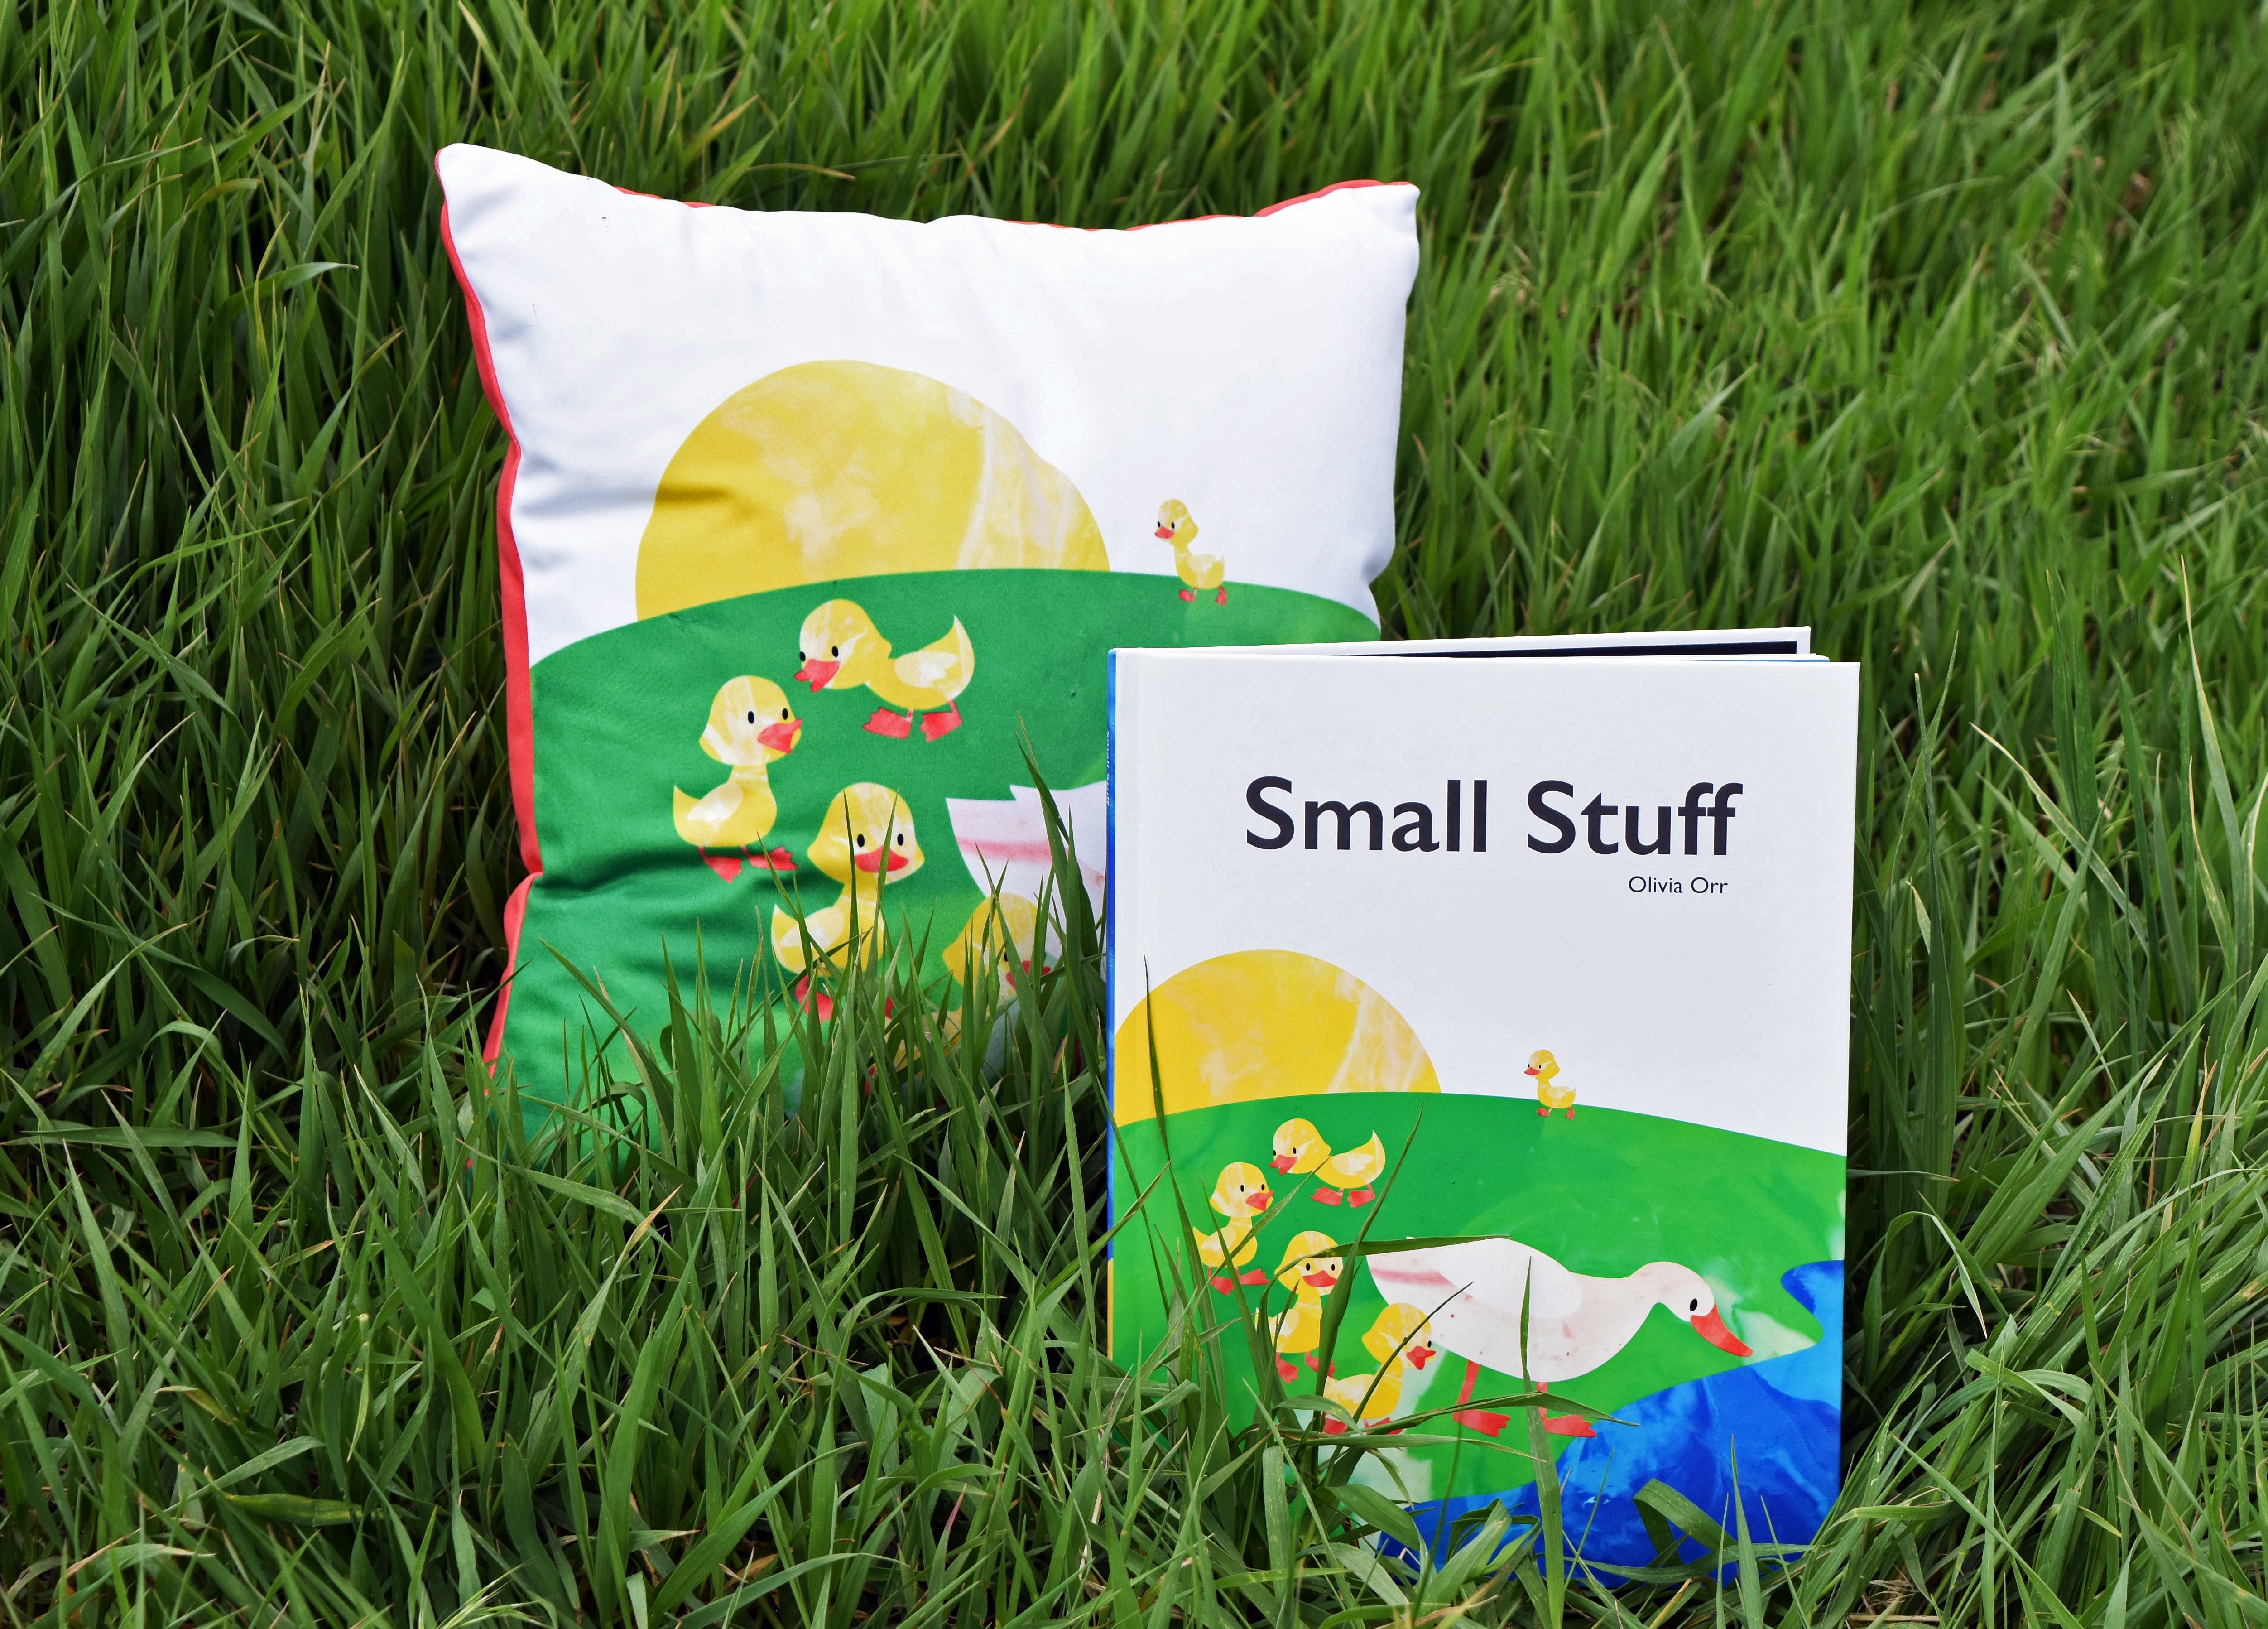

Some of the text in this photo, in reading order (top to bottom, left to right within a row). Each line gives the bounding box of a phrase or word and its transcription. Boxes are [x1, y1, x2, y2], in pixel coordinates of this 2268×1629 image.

[1246, 776, 1743, 856] Small Stuff
[1629, 876, 1729, 894] Olivia Orr
